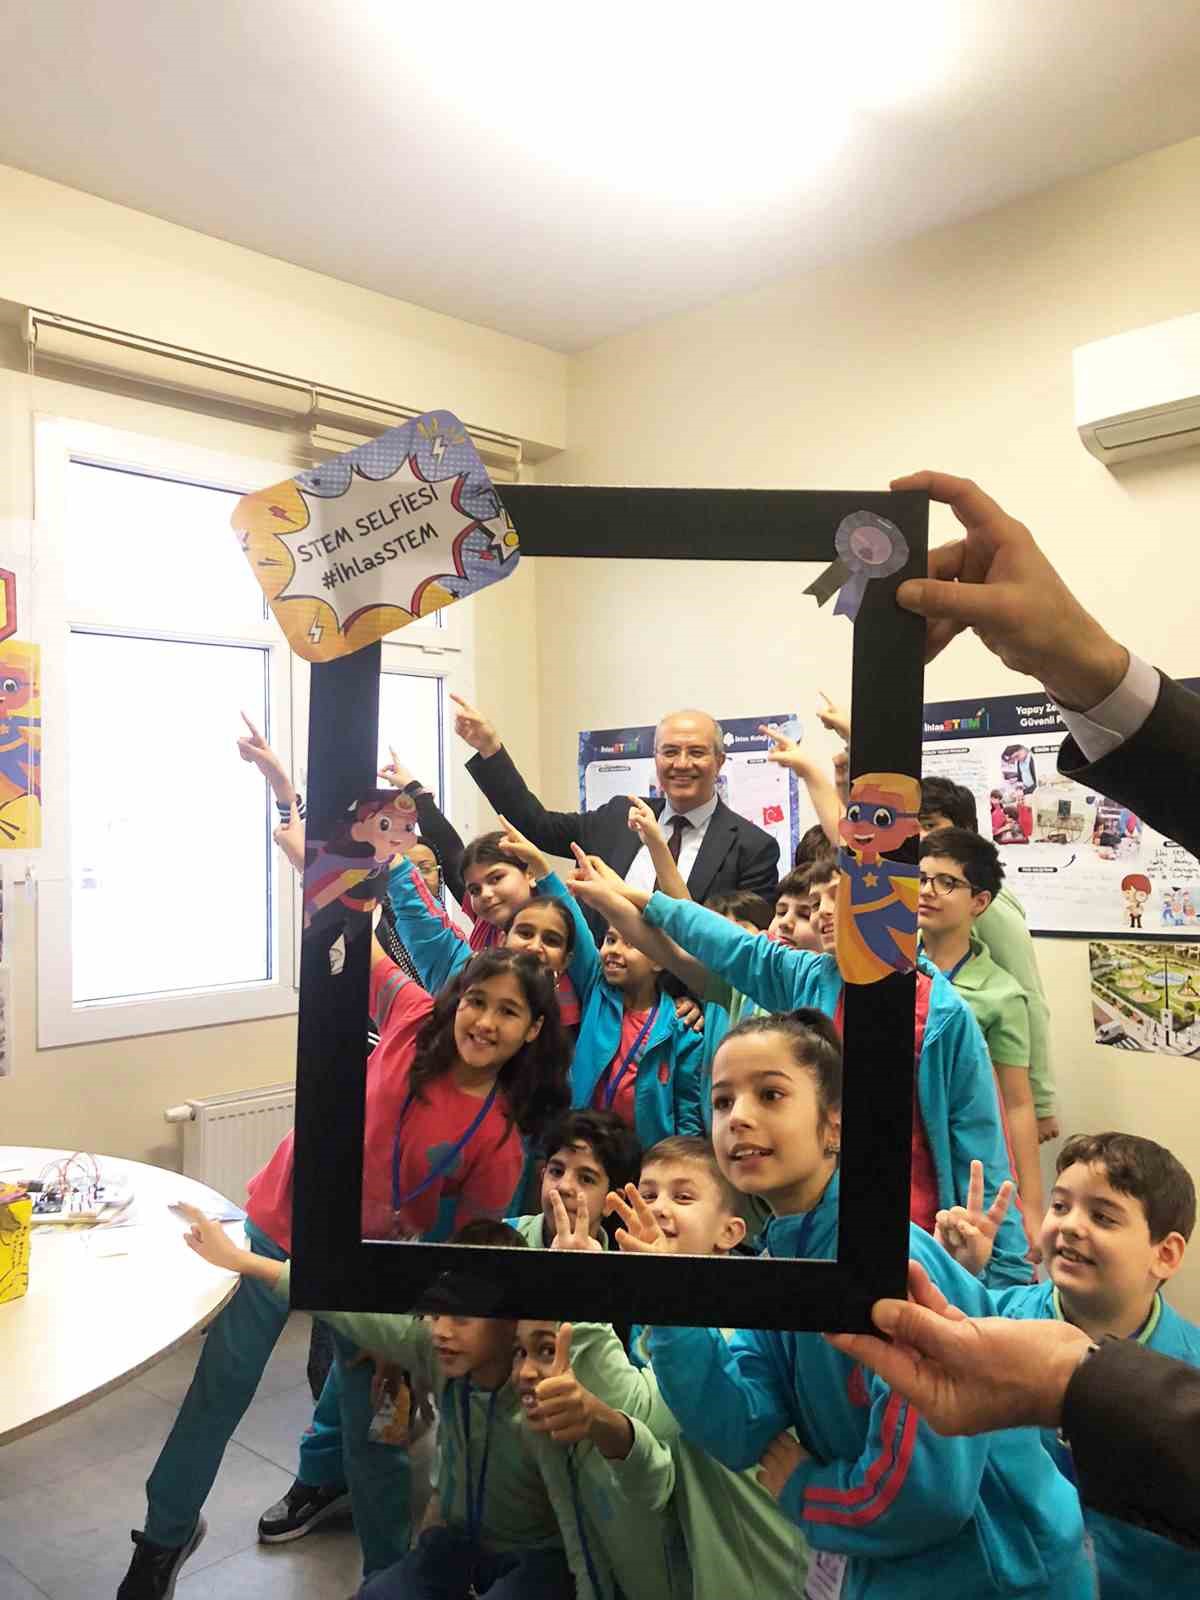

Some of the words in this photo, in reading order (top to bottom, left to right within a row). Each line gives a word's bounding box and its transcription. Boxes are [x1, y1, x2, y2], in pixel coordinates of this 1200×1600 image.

[297, 526, 353, 563] STEM
[1015, 703, 1044, 716] Yapay
[1020, 715, 1055, 727] Güvenli
